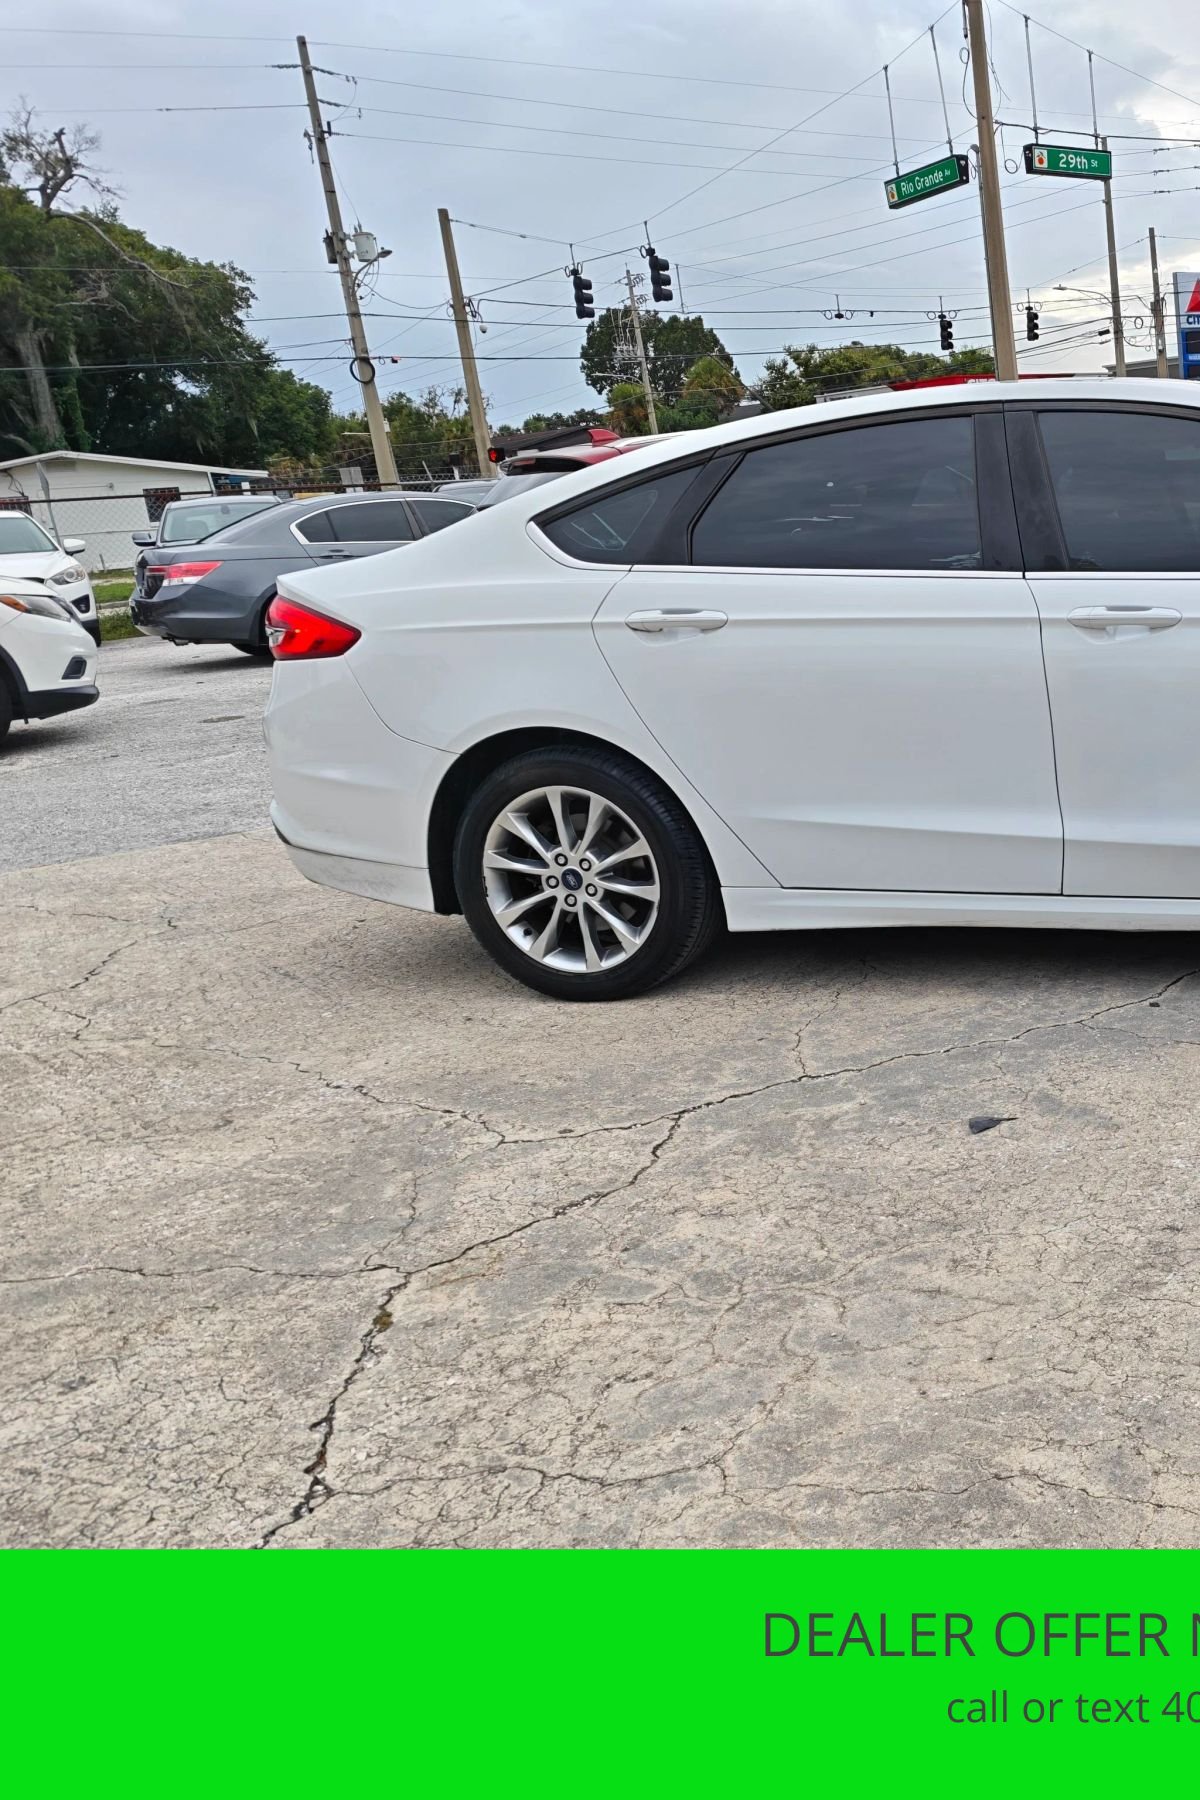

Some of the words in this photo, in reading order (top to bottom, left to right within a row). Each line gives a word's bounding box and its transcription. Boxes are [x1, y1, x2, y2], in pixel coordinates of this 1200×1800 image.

[1058, 153, 1089, 170] 29th
[1091, 159, 1098, 168] St
[901, 177, 915, 196] Rio
[915, 169, 944, 190] Grande
[944, 168, 951, 177] Av
